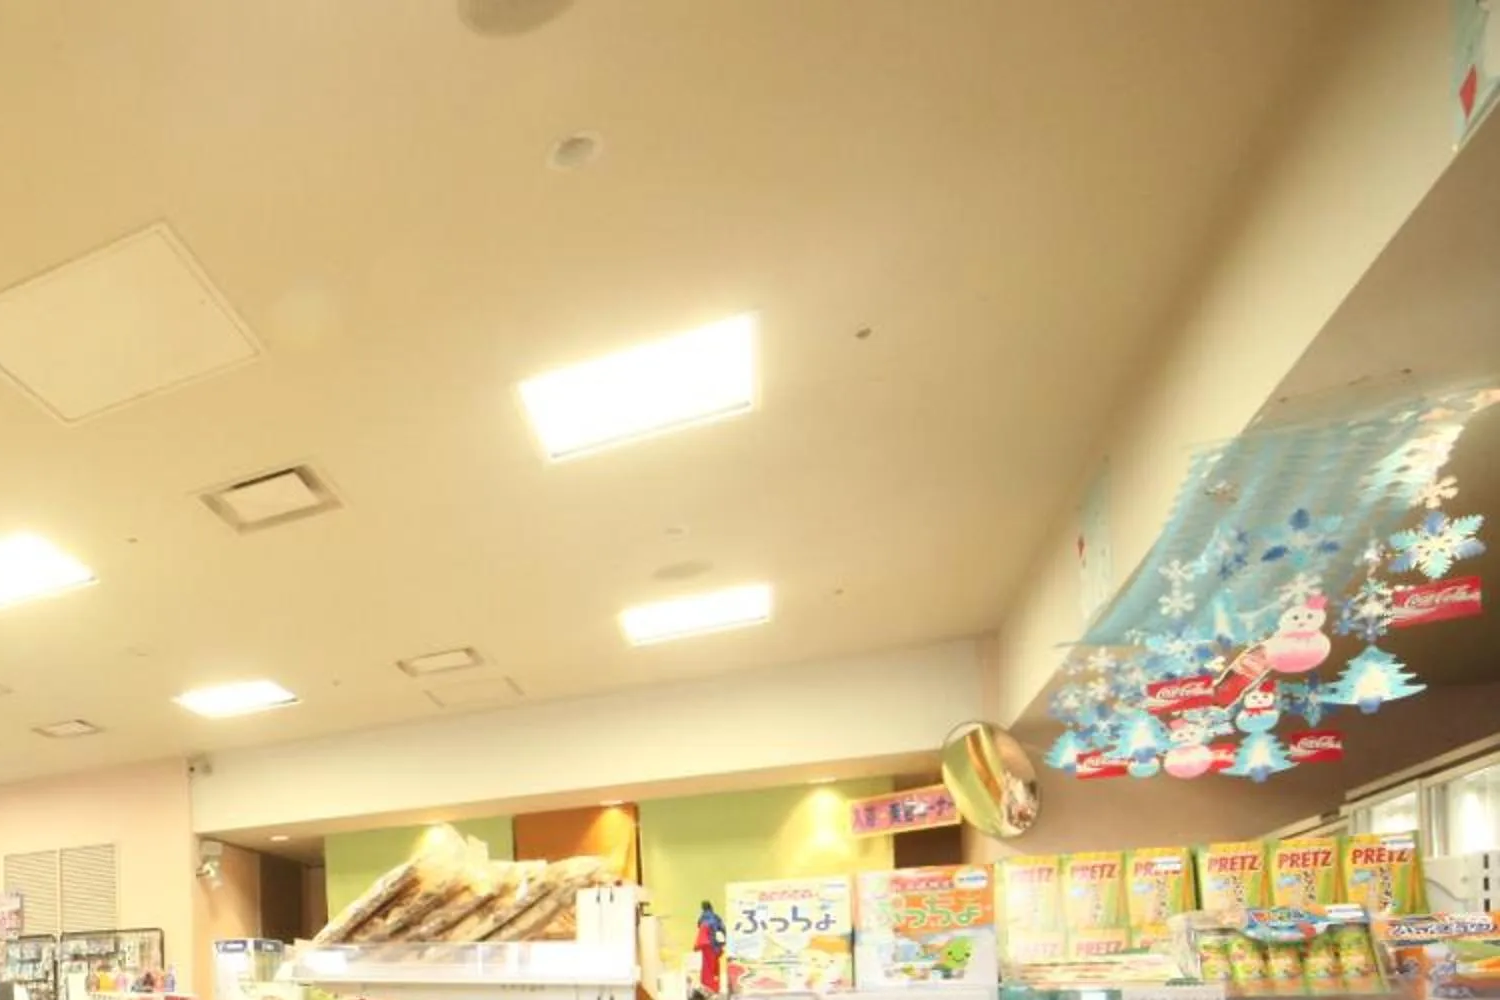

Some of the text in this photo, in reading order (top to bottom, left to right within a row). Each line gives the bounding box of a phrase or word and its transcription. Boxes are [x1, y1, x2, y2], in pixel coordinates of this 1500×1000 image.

[1207, 855, 1259, 872] PRETZ
[1277, 850, 1332, 868] PRETZ
[1351, 847, 1412, 865] PRETZ
[1070, 863, 1117, 880] PRETZ
